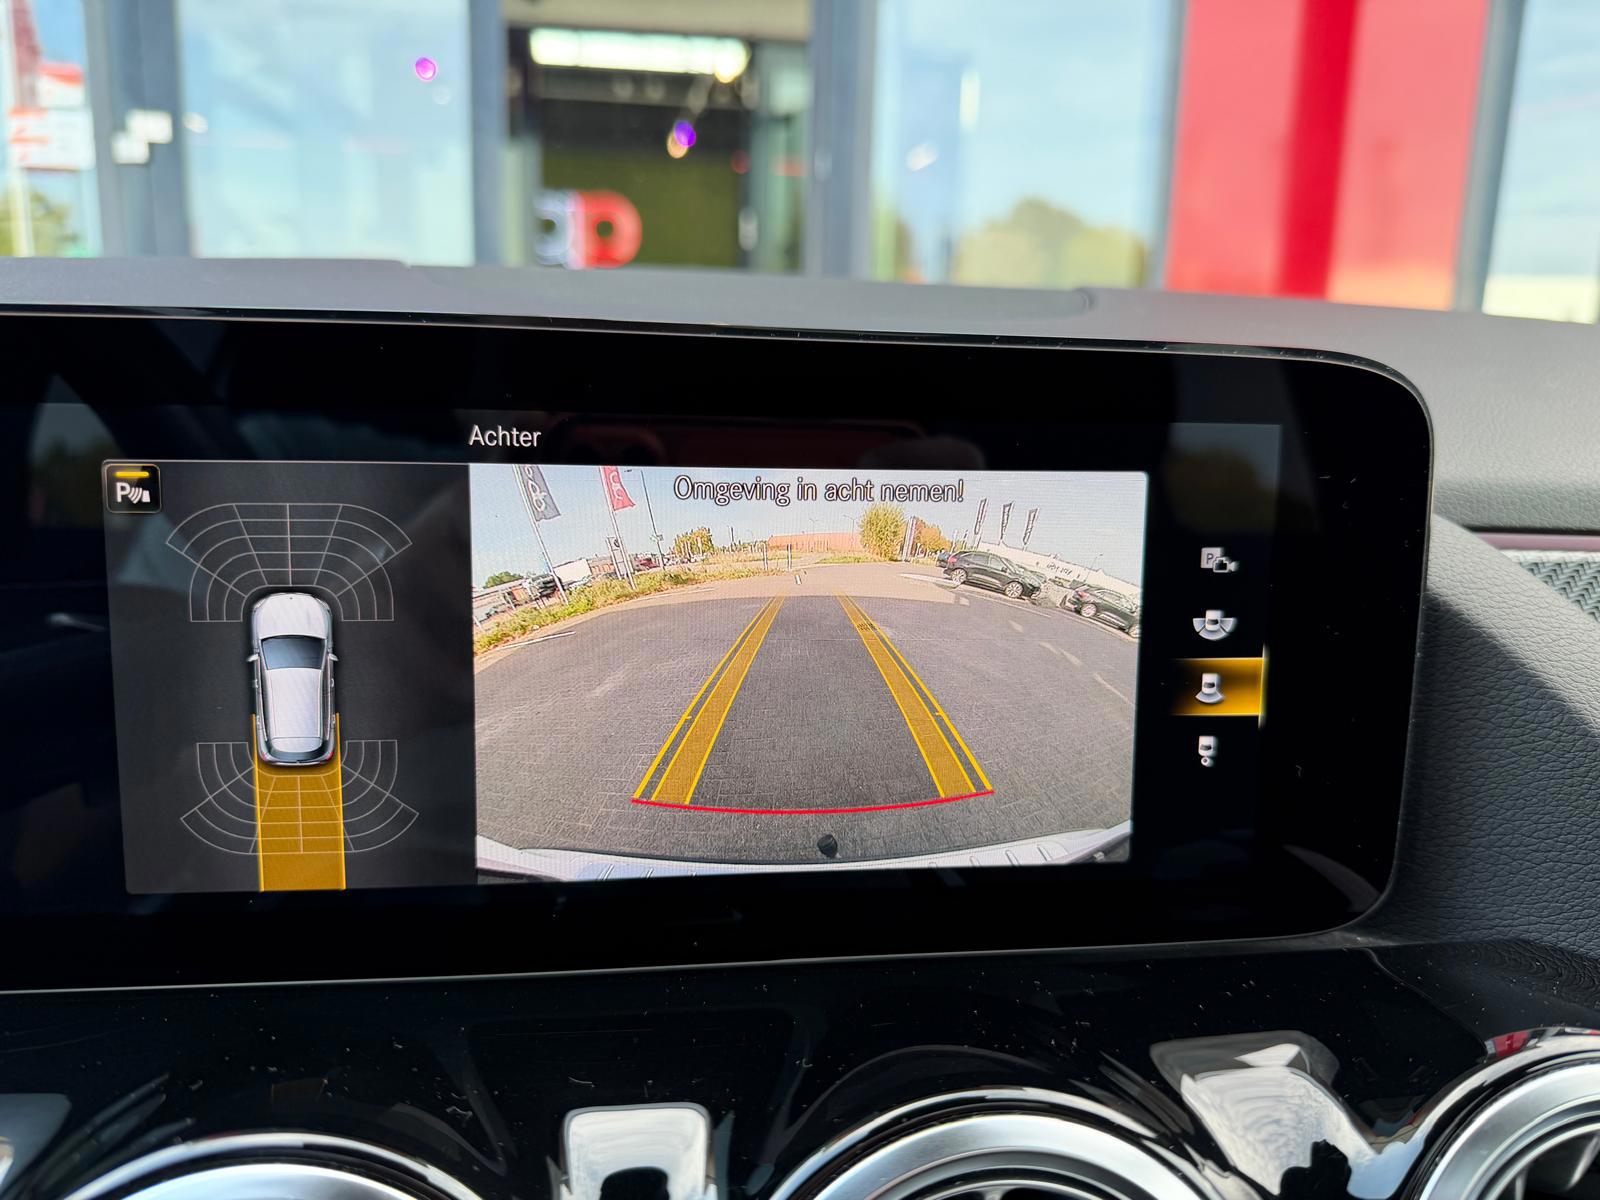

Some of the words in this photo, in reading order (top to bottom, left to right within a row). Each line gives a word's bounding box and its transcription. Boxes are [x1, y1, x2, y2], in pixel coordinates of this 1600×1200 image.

[468, 424, 542, 447] Achter
[674, 474, 791, 506] Omgeving
[797, 476, 818, 501] in
[824, 477, 875, 502] acht
[880, 479, 964, 503] nemen!
